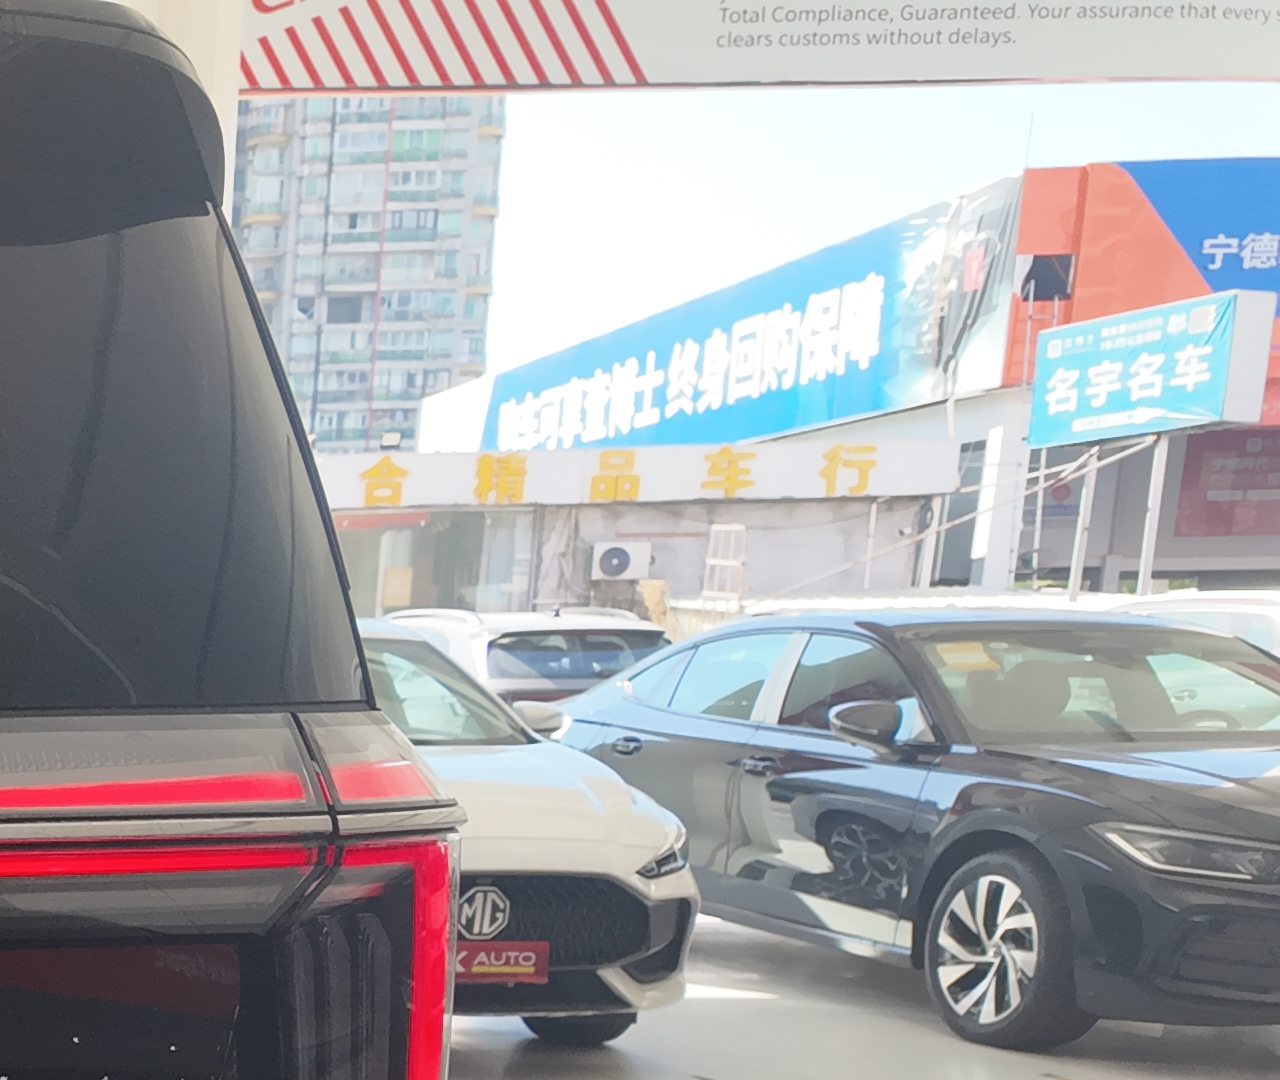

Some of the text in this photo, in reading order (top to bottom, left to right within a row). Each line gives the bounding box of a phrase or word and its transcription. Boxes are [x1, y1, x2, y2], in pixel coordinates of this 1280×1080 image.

[719, 3, 1271, 25] Total Compliance, Guaranteed. Your assurance that every
[715, 27, 1017, 48] clears customs without delays.
[460, 891, 505, 935] MG
[473, 951, 537, 966] AUTO
